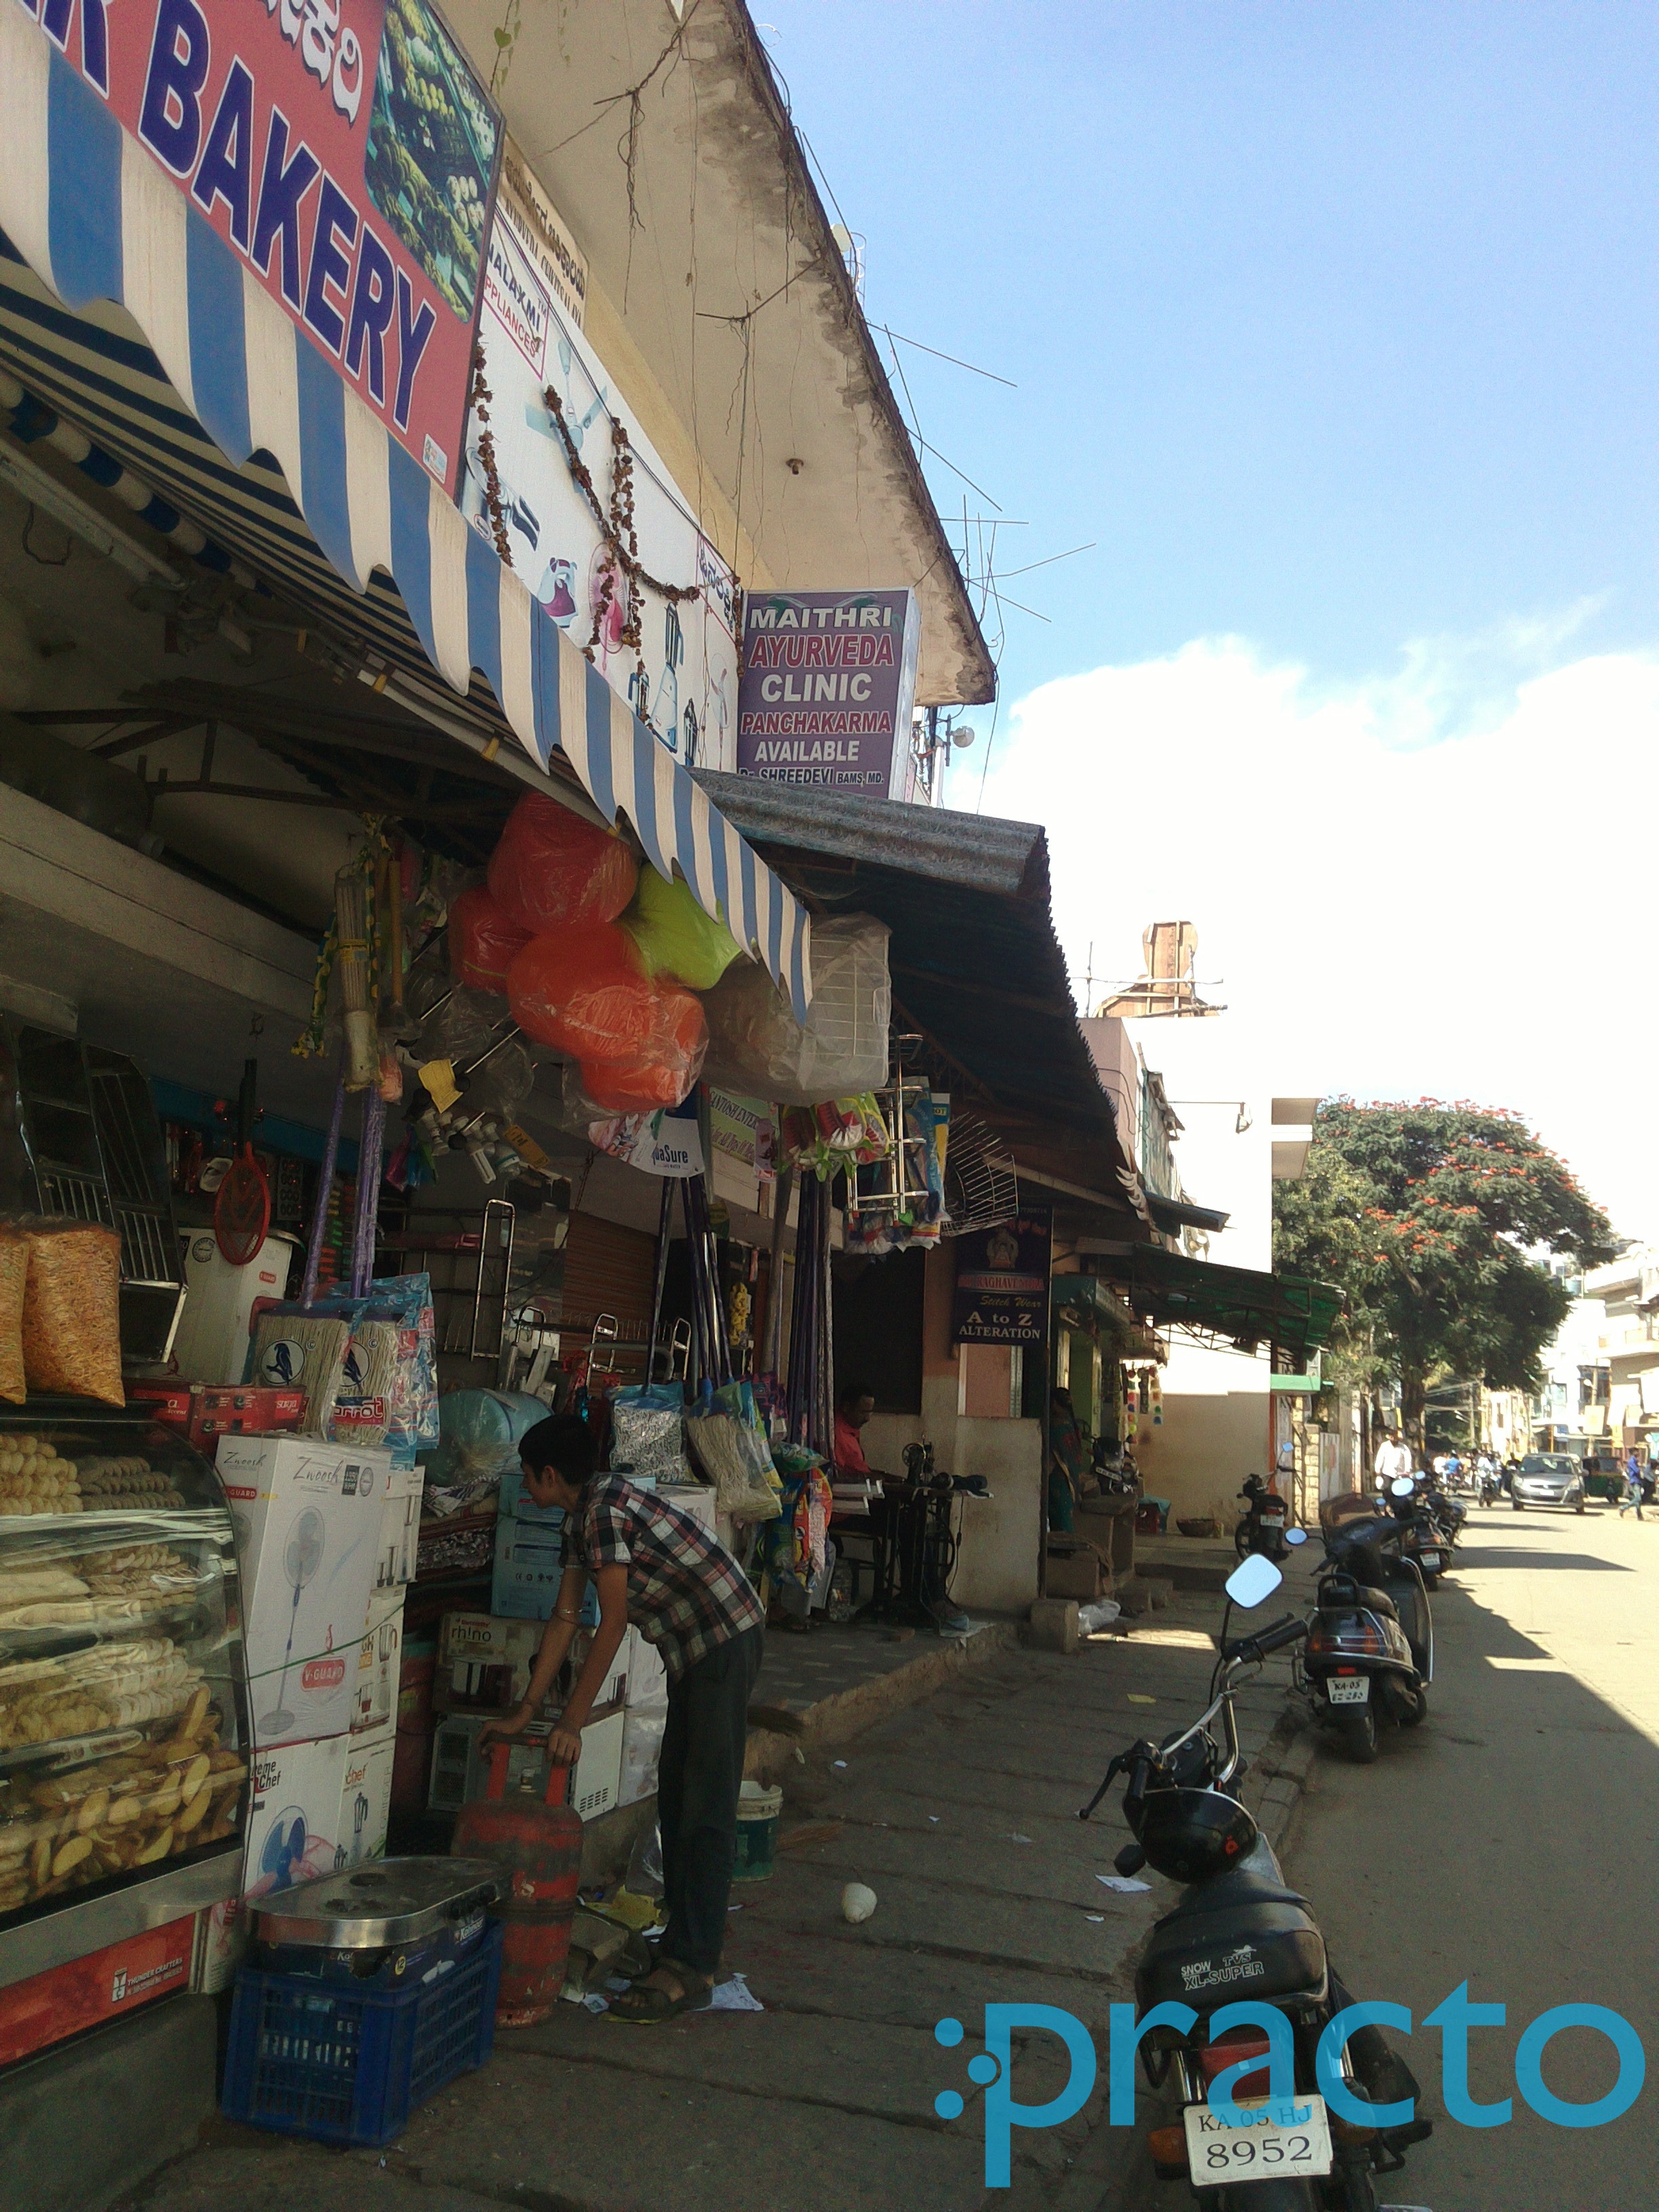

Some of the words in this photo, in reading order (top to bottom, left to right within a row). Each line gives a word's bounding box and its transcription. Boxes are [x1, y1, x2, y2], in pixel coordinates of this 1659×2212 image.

[138, 0, 436, 434] BAKERY
[488, 243, 541, 332] NALAXMI
[484, 274, 537, 357] PPLIANCES
[750, 607, 892, 628] MAITHRI
[748, 634, 895, 668] AYURVEDA
[761, 673, 872, 702] CLINIC
[741, 711, 892, 735] PANCHAKARMA
[754, 740, 859, 762] AVAILABLE
[759, 767, 834, 784] SHREEDEVI
[966, 1311, 983, 1324] A
[992, 1313, 1010, 1324] to
[1018, 1313, 1032, 1326] Z
[958, 1325, 1041, 1339] ALTERATION
[228, 1488, 255, 1499] -GUARD
[1181, 1960, 1211, 1977] SNOW
[1223, 1952, 1251, 1967] TVS
[1198, 2114, 1232, 2133] KA
[1240, 2108, 1269, 2127] 05
[1278, 2104, 1312, 2125] HJ
[1207, 2136, 1312, 2169] 8952
